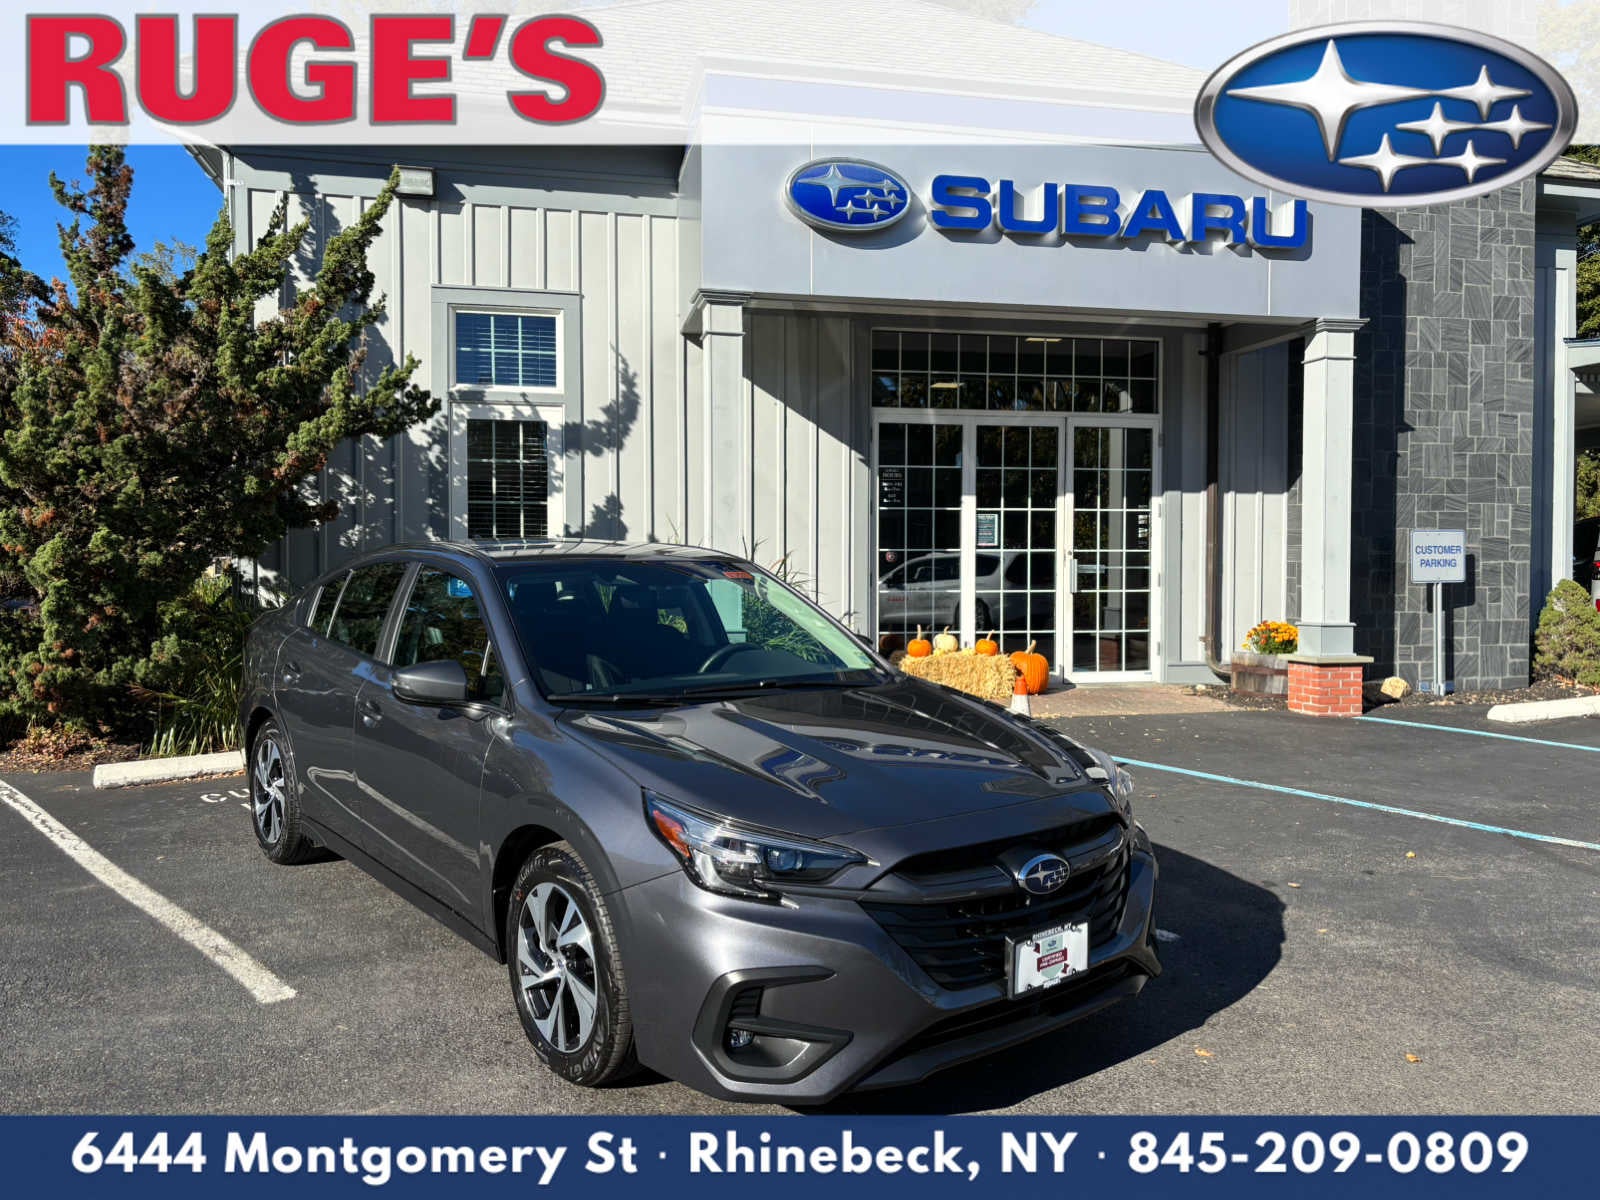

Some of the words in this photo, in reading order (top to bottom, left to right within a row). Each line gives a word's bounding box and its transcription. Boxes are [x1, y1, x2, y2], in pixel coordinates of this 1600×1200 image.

[931, 174, 1308, 248] SUBARU
[1415, 545, 1462, 555] CUSTOMER
[1420, 559, 1457, 568] PARKING
